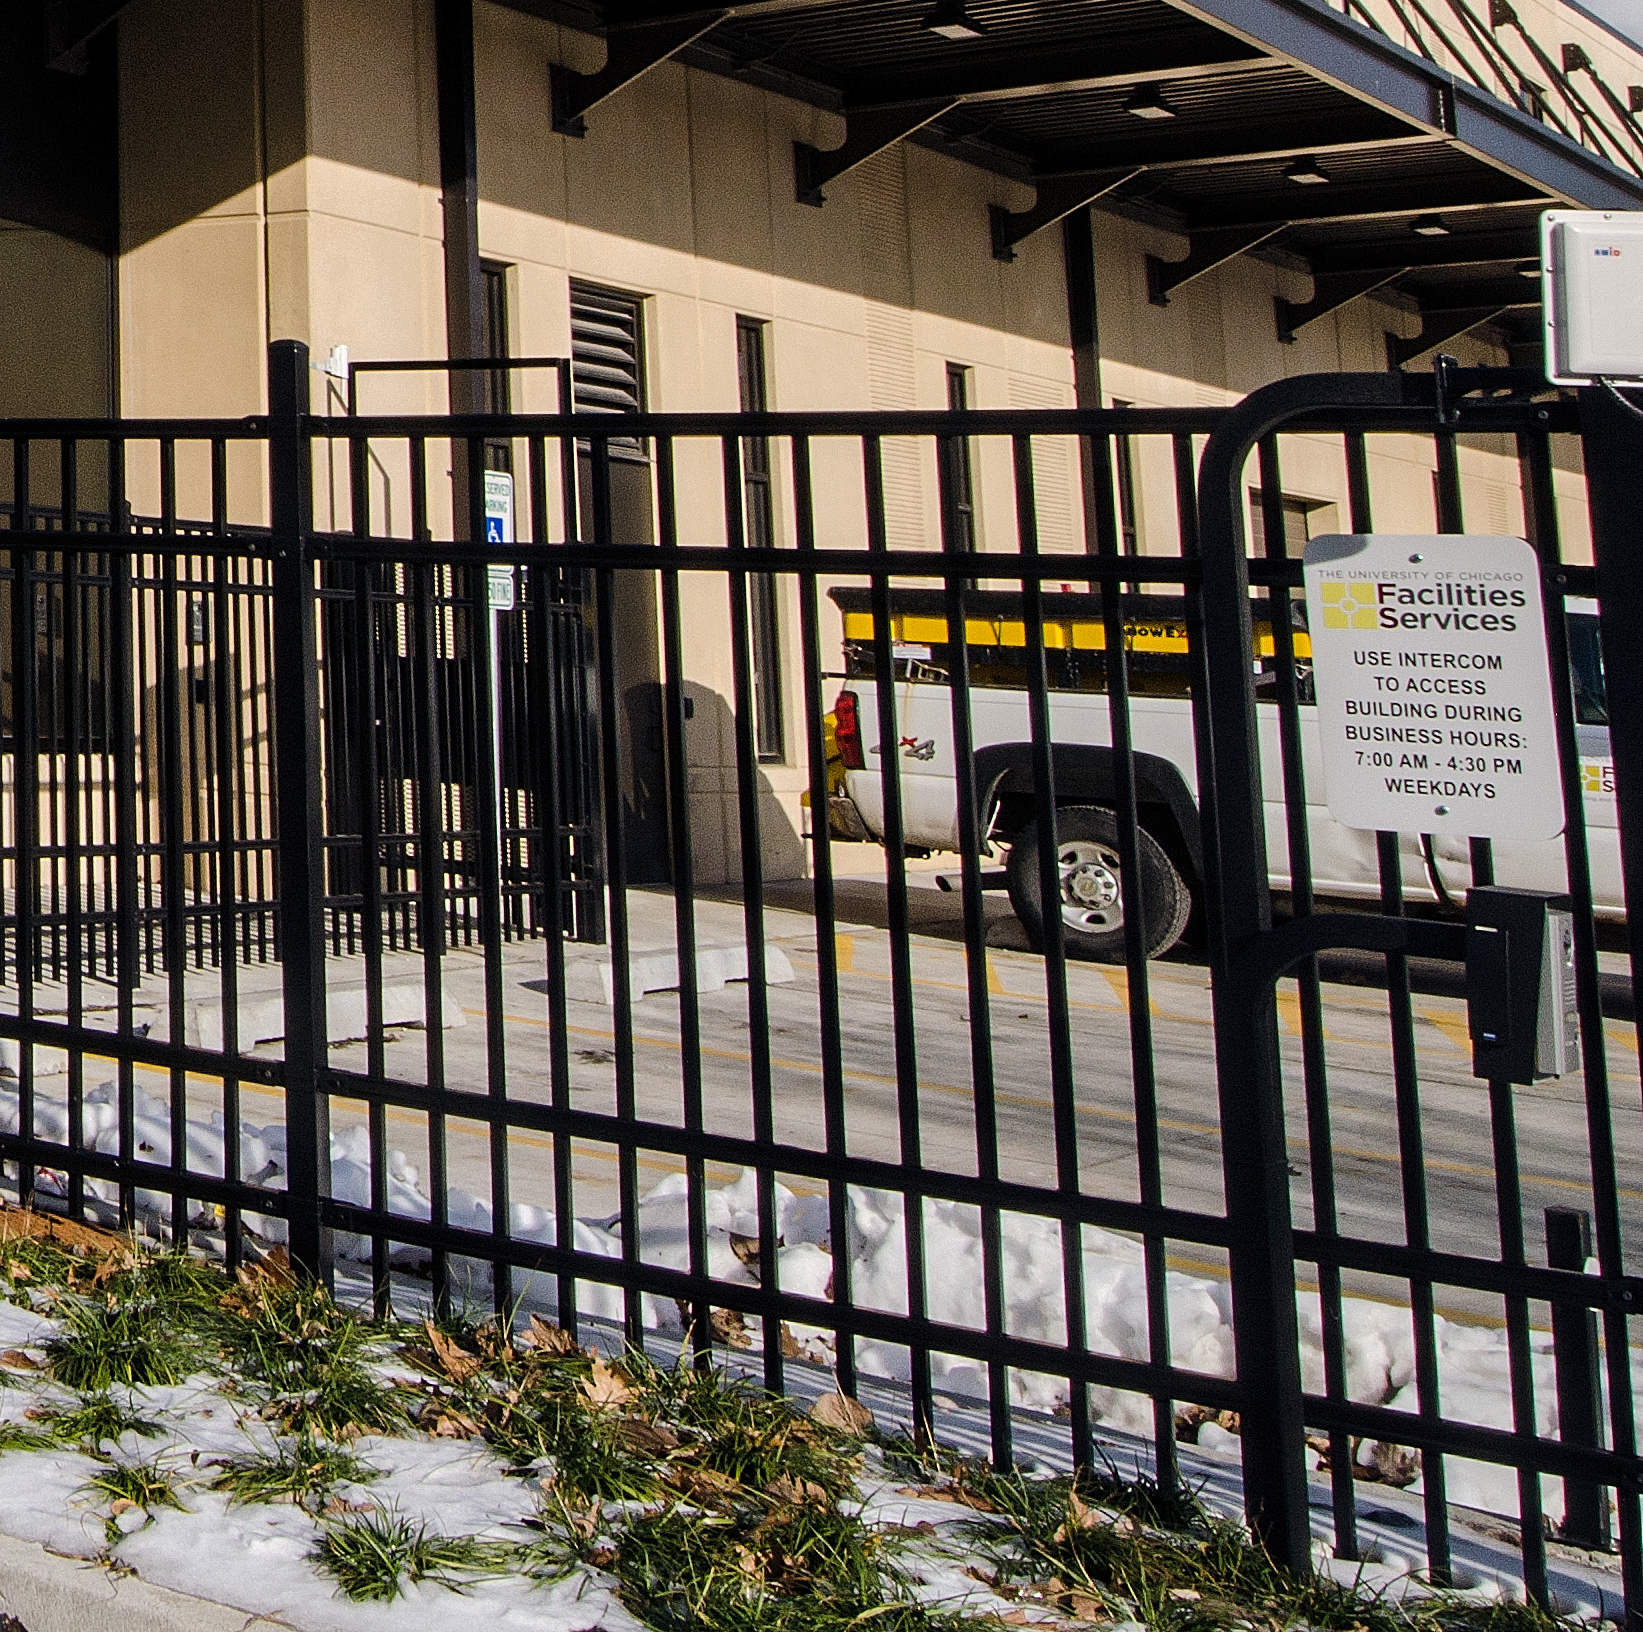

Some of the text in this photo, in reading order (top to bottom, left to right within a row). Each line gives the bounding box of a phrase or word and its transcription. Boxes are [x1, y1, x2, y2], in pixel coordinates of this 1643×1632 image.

[486, 482, 510, 496] SERVED
[1318, 570, 1524, 582] THE UNIVERSITY OF CHICAGO
[1377, 582, 1527, 608] Facilities
[1379, 607, 1517, 632] Services
[1353, 650, 1503, 670] USE INTERCOM
[1374, 676, 1487, 696] TO ACCESS
[1345, 700, 1522, 723] BUILDING DURING
[1345, 725, 1528, 749] BUSINESS HOURS:
[1355, 751, 1393, 767] 7:00
[1399, 754, 1429, 769] AM
[1447, 756, 1486, 772] 4:30
[1493, 758, 1522, 774] PM
[1384, 777, 1496, 799] WEEKDAYS
